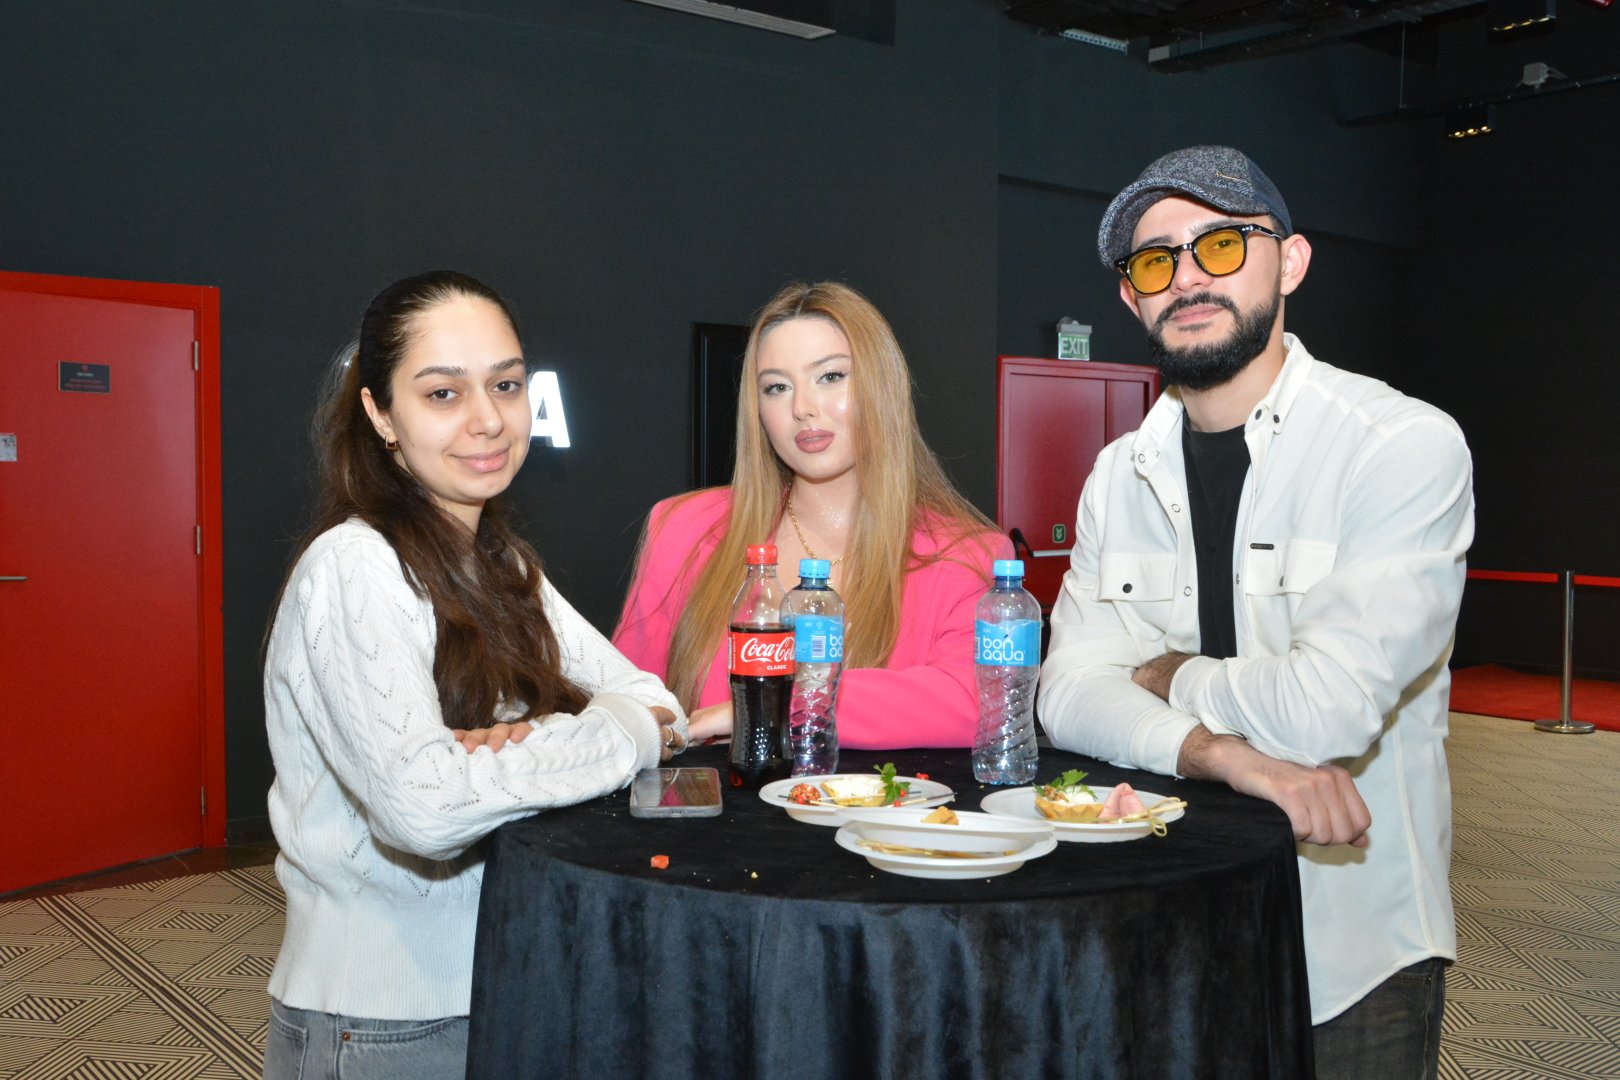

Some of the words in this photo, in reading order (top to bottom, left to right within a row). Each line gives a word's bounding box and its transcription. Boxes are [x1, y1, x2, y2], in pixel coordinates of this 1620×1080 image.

[1062, 337, 1088, 355] EXIT
[527, 371, 571, 448] A
[983, 635, 1014, 650] bon
[983, 649, 1024, 663] aqua
